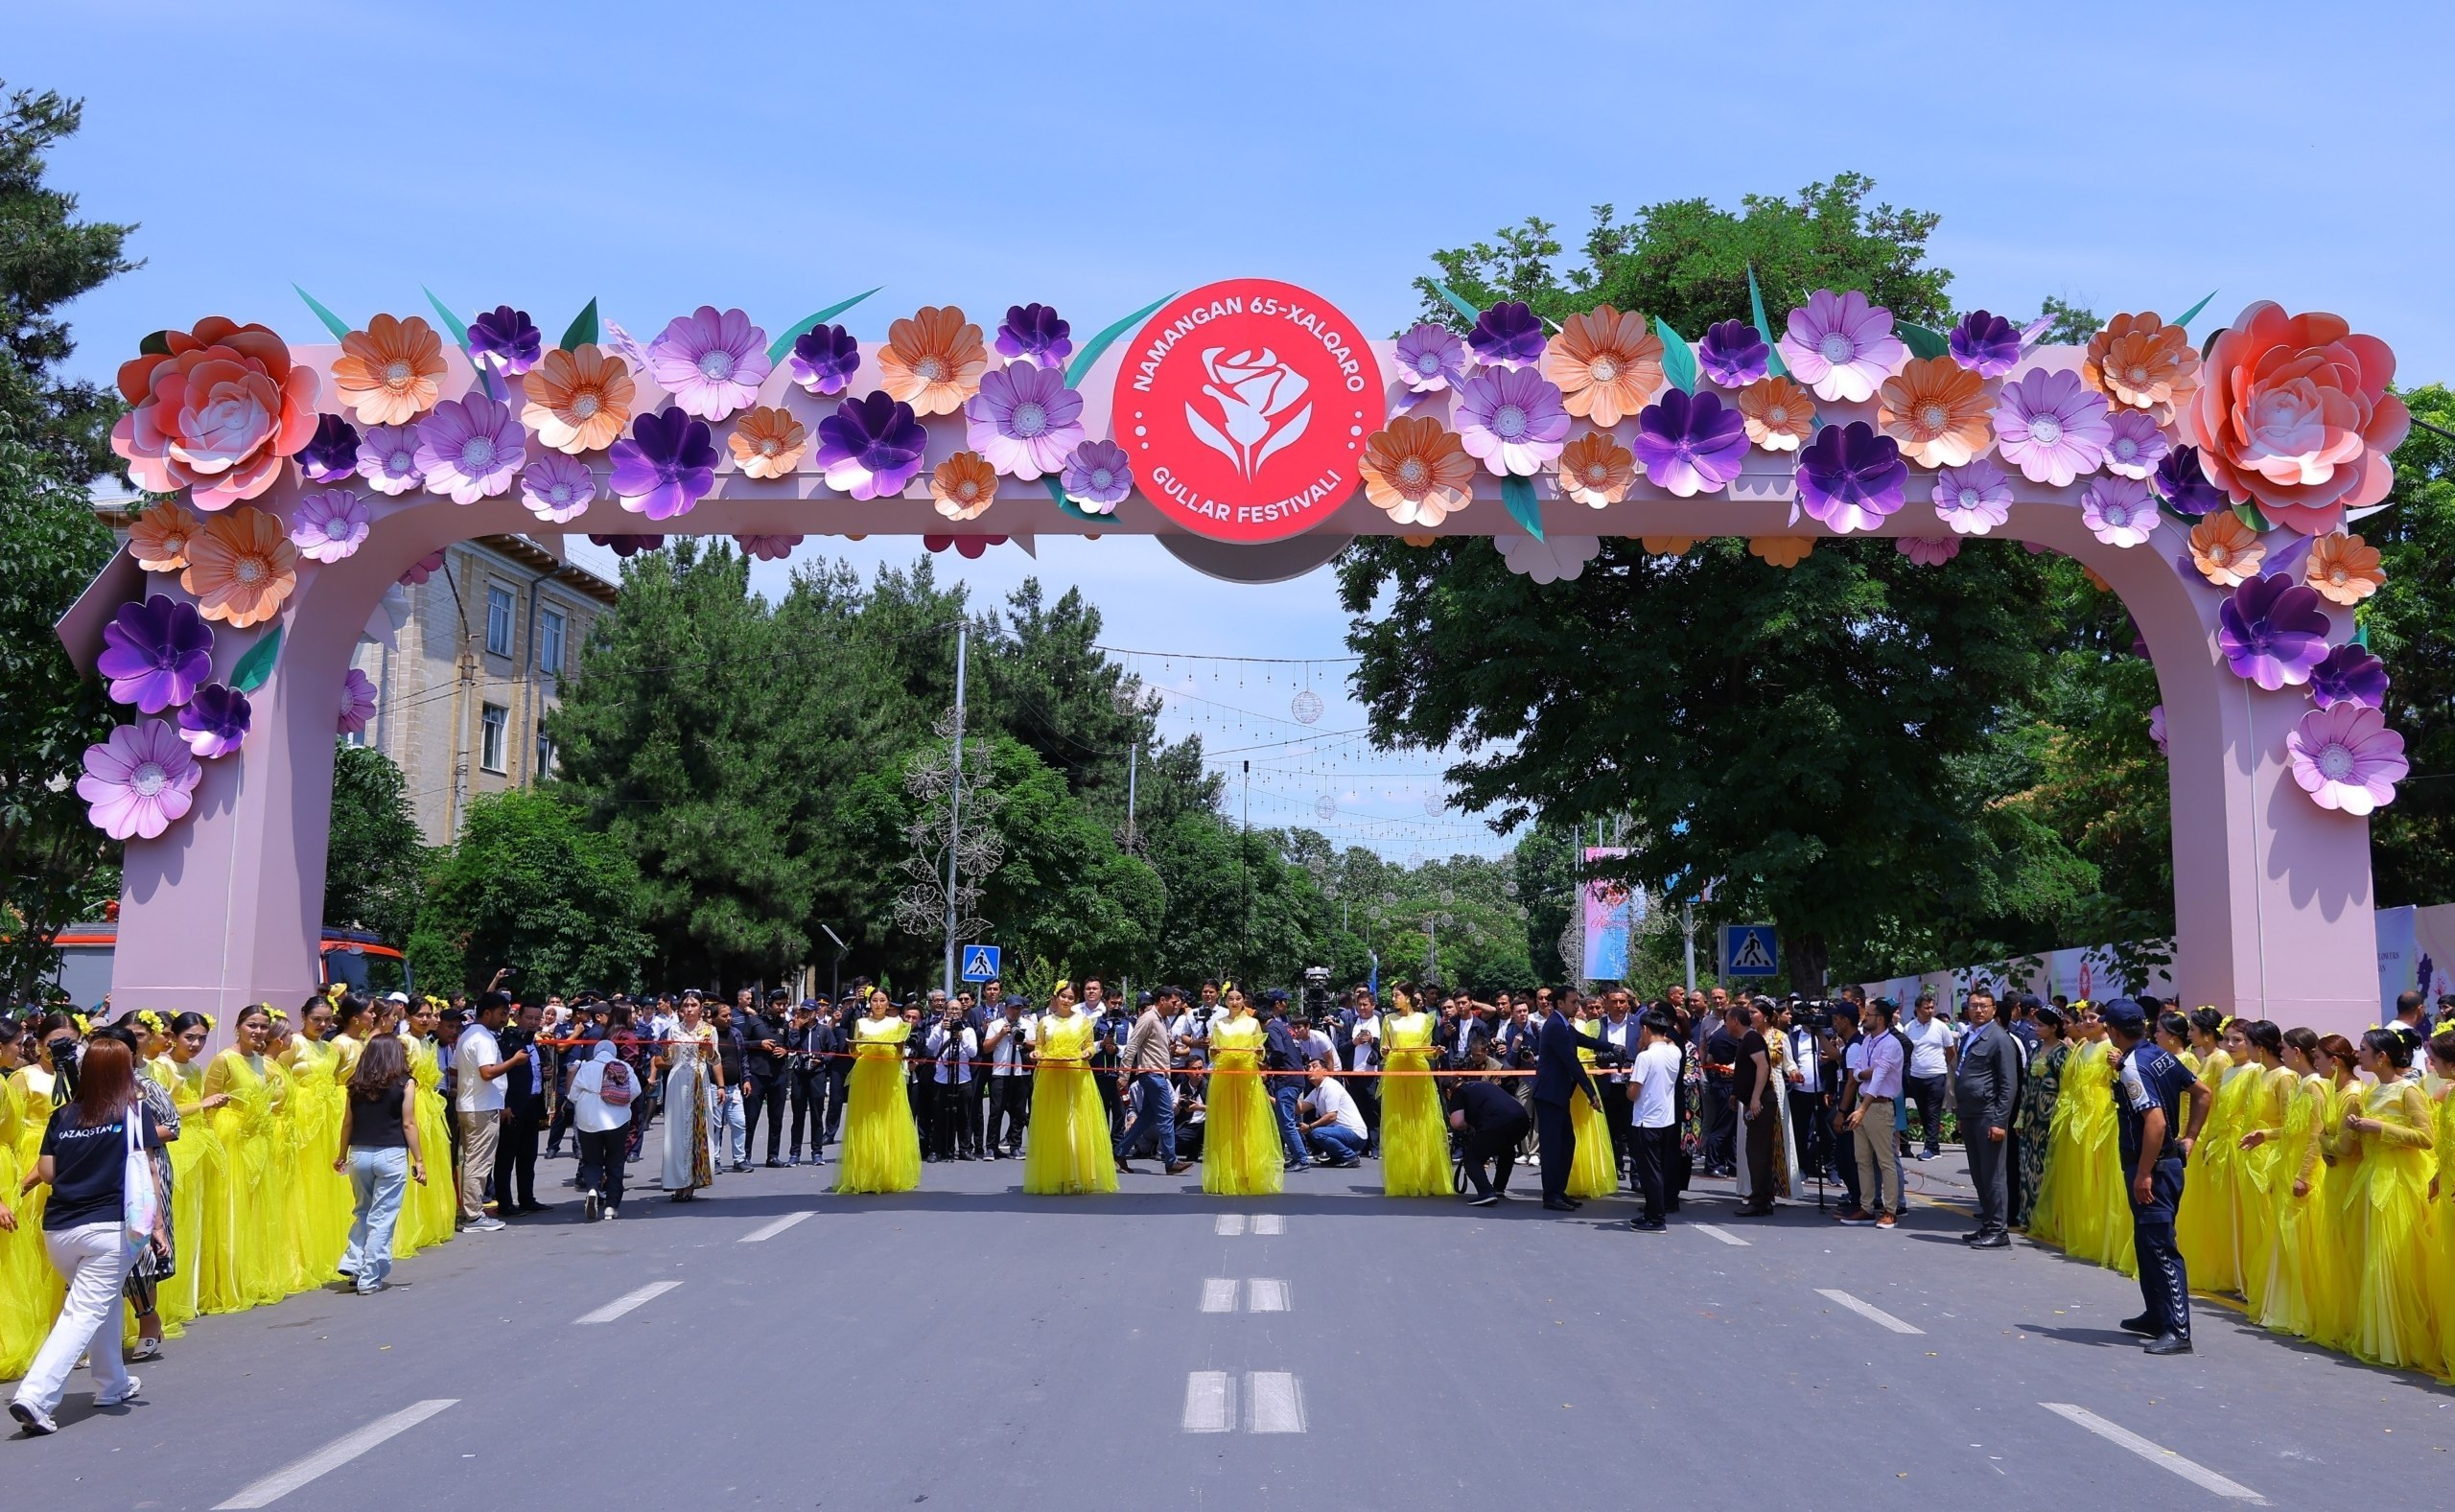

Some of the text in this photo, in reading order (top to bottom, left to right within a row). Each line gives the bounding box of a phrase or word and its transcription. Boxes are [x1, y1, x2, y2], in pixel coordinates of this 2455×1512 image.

[1133, 296, 1366, 392] NAMANGAN 65-XALQARO
[1152, 466, 1343, 523] GULLAR FESTIVALI
[2377, 951, 2399, 960] LOWERS
